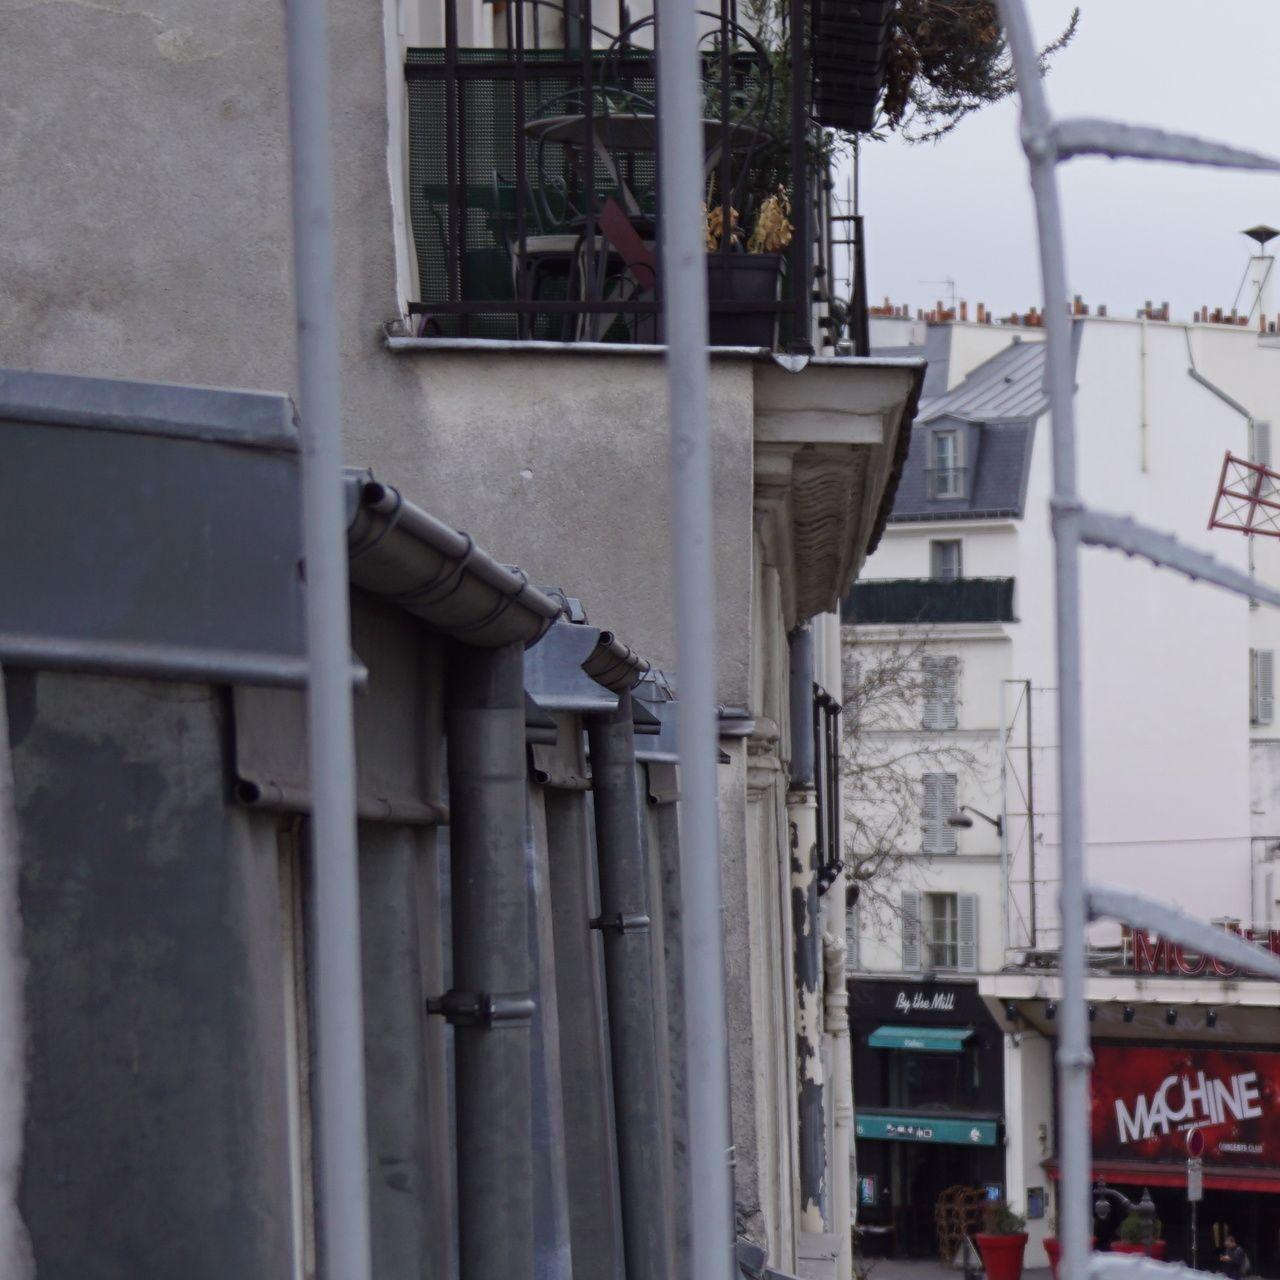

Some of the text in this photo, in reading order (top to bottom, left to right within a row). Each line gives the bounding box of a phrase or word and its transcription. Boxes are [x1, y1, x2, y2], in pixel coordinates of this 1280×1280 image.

[895, 992, 955, 1014] By the Mill
[1115, 1071, 1262, 1143] MACHINE
